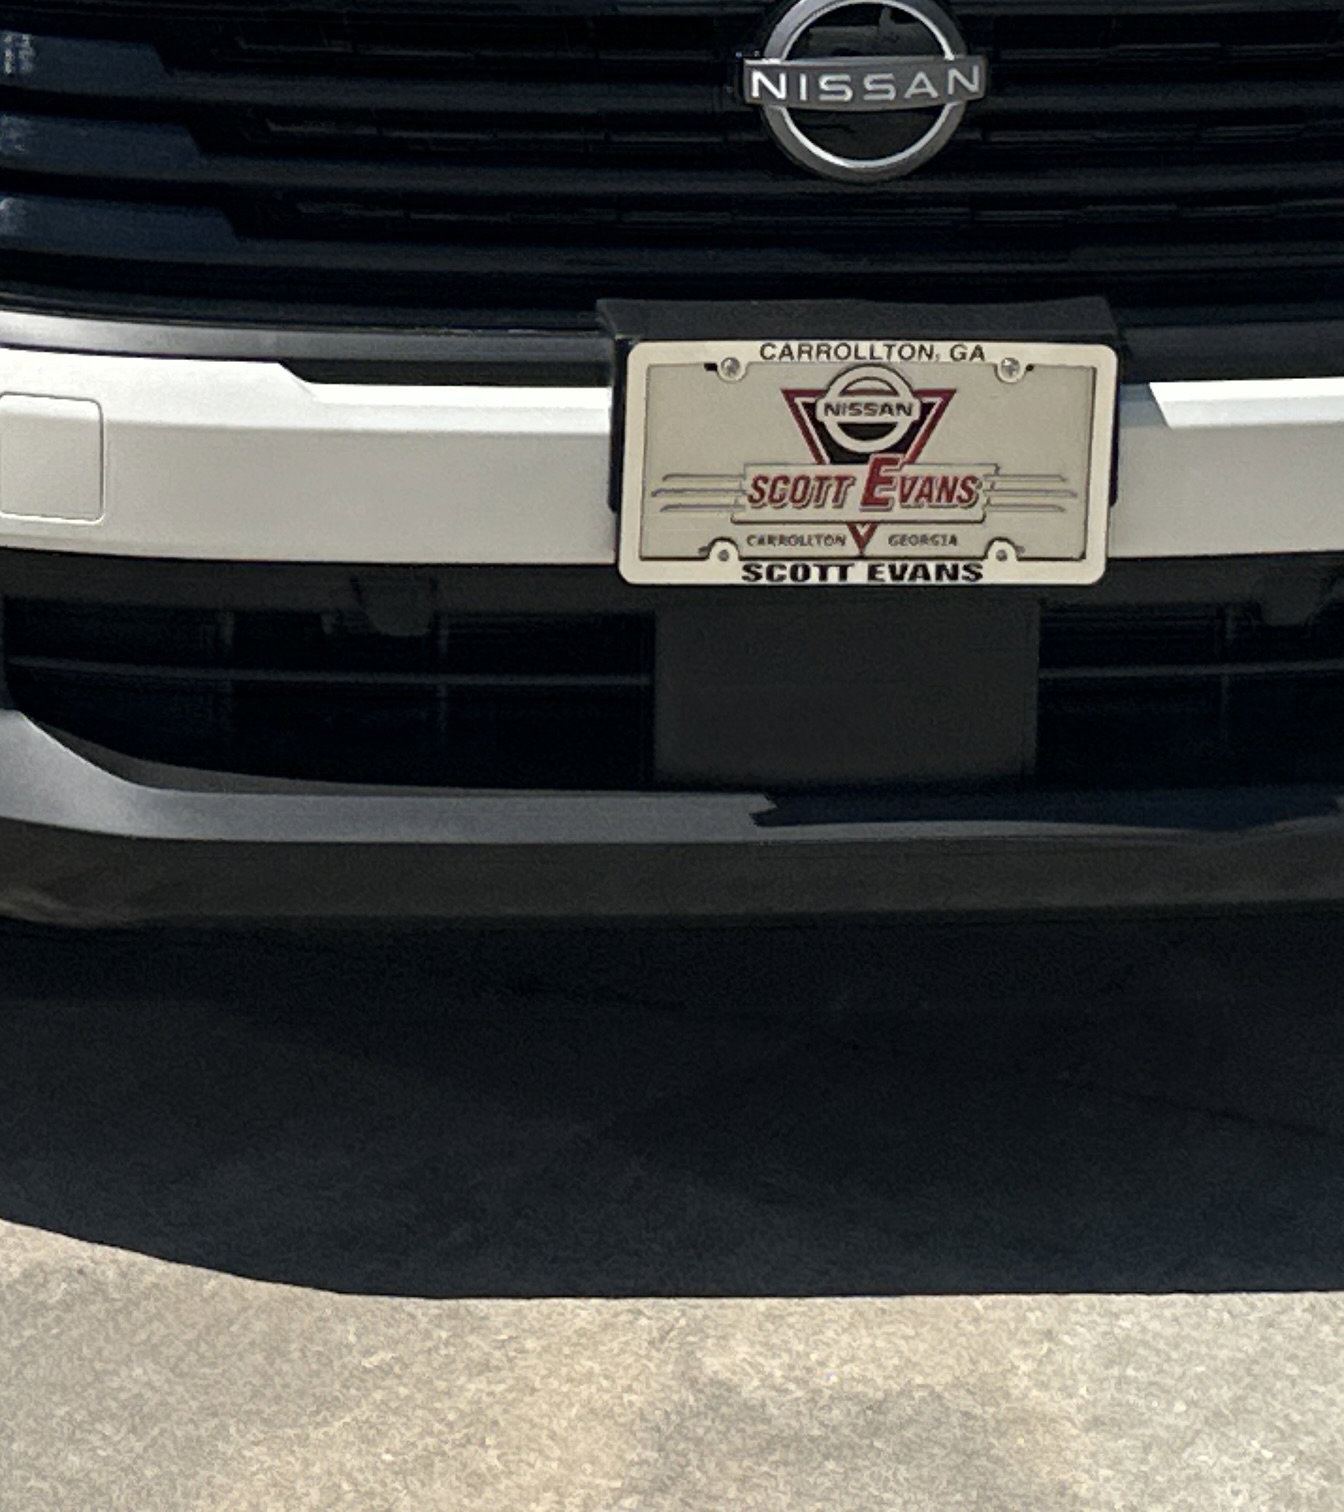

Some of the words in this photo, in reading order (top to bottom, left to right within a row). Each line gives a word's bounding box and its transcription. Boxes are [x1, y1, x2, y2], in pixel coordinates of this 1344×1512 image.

[751, 65, 980, 102] NISSAN
[759, 342, 941, 361] CARROLLTON,
[949, 343, 986, 362] GA
[823, 402, 914, 417] NISSAN
[747, 473, 856, 508] SCOTT
[859, 454, 983, 512] EVANS
[746, 533, 847, 547] CARROLLTON
[888, 533, 958, 547] GEORGIA
[741, 562, 855, 583] SCOTT
[867, 562, 984, 583] EVANS
